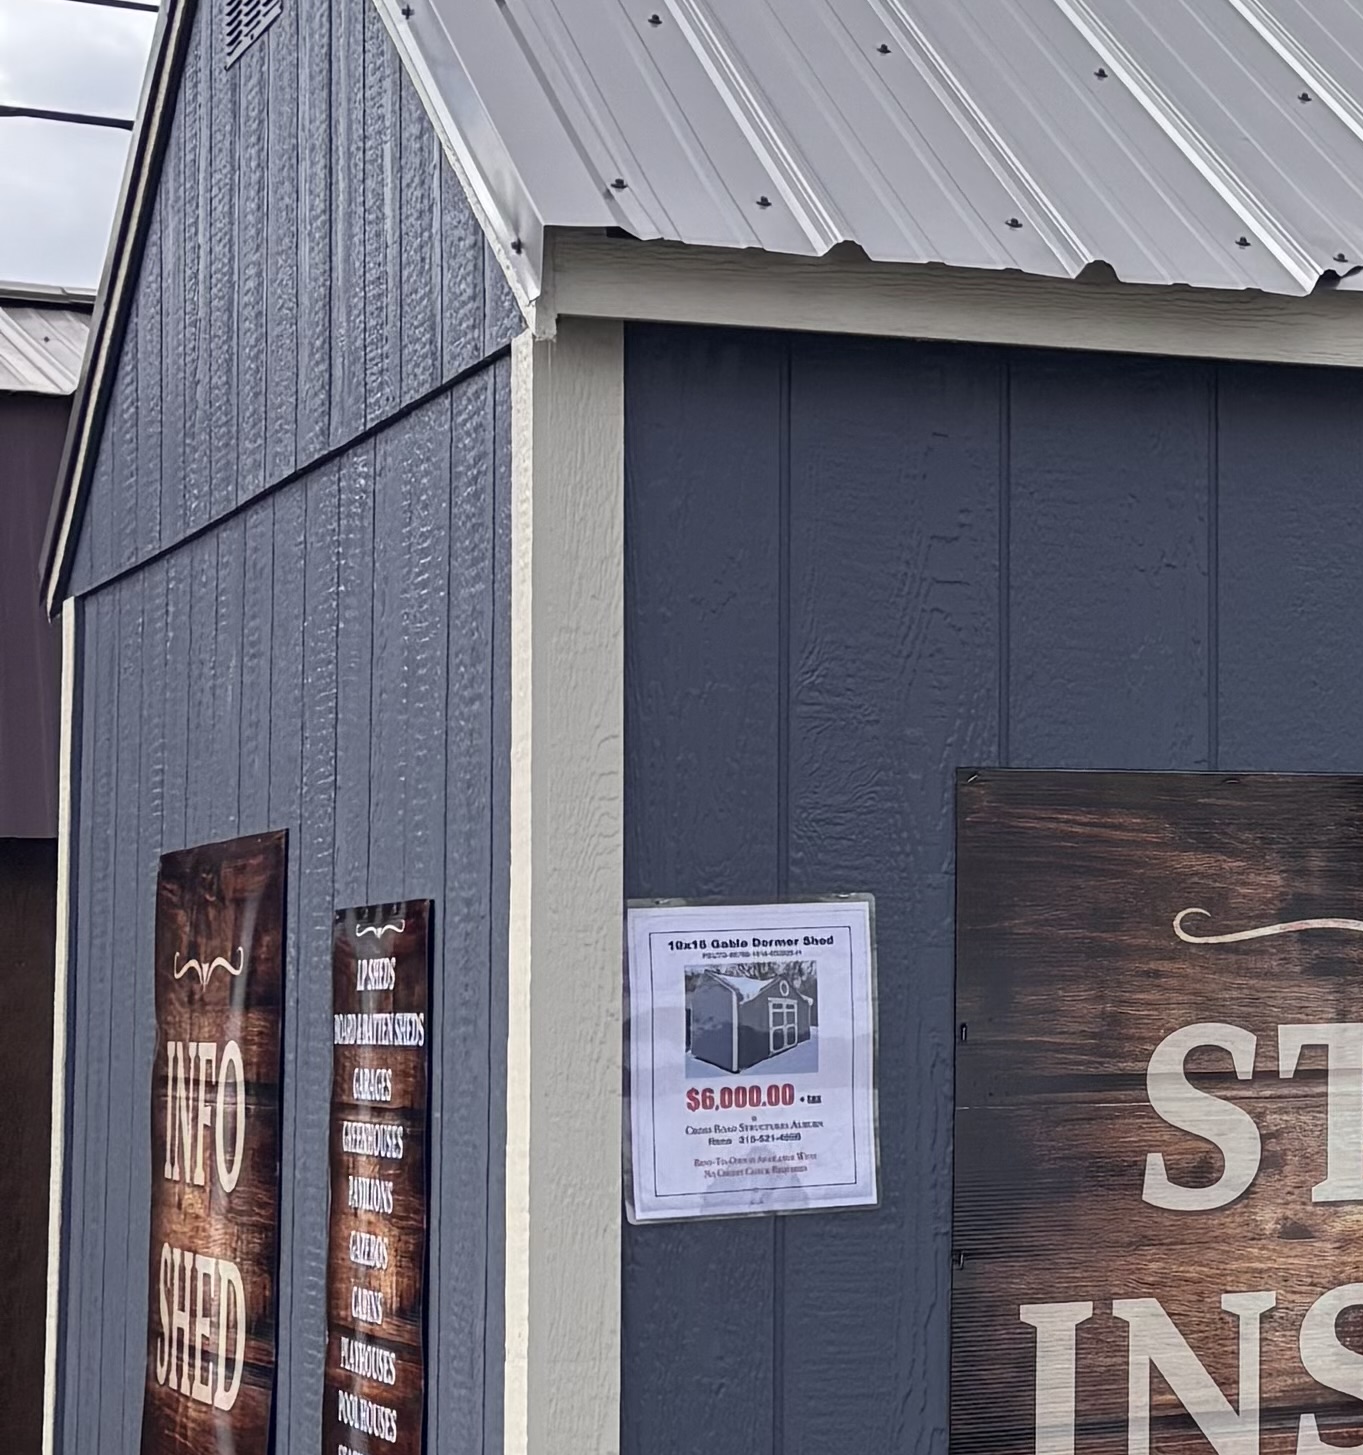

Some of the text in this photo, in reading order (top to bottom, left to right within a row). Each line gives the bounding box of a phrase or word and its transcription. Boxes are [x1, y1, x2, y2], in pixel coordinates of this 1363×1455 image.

[752, 937, 800, 948] Dormer
[803, 935, 834, 946] Shed
[368, 957, 396, 991] SHEDS
[394, 1013, 425, 1046] SHEDS
[353, 1067, 393, 1102] GARAGES
[686, 1083, 795, 1112] $6,000.00
[164, 1040, 245, 1192] INFO
[342, 1121, 404, 1159] GREENHOUSES
[348, 1175, 394, 1214] PAVILIONS
[349, 1230, 389, 1270] GAZEBOS
[352, 1285, 383, 1325] CABINS
[156, 1242, 246, 1411] SHED
[340, 1336, 396, 1386] PLAYHOUSES
